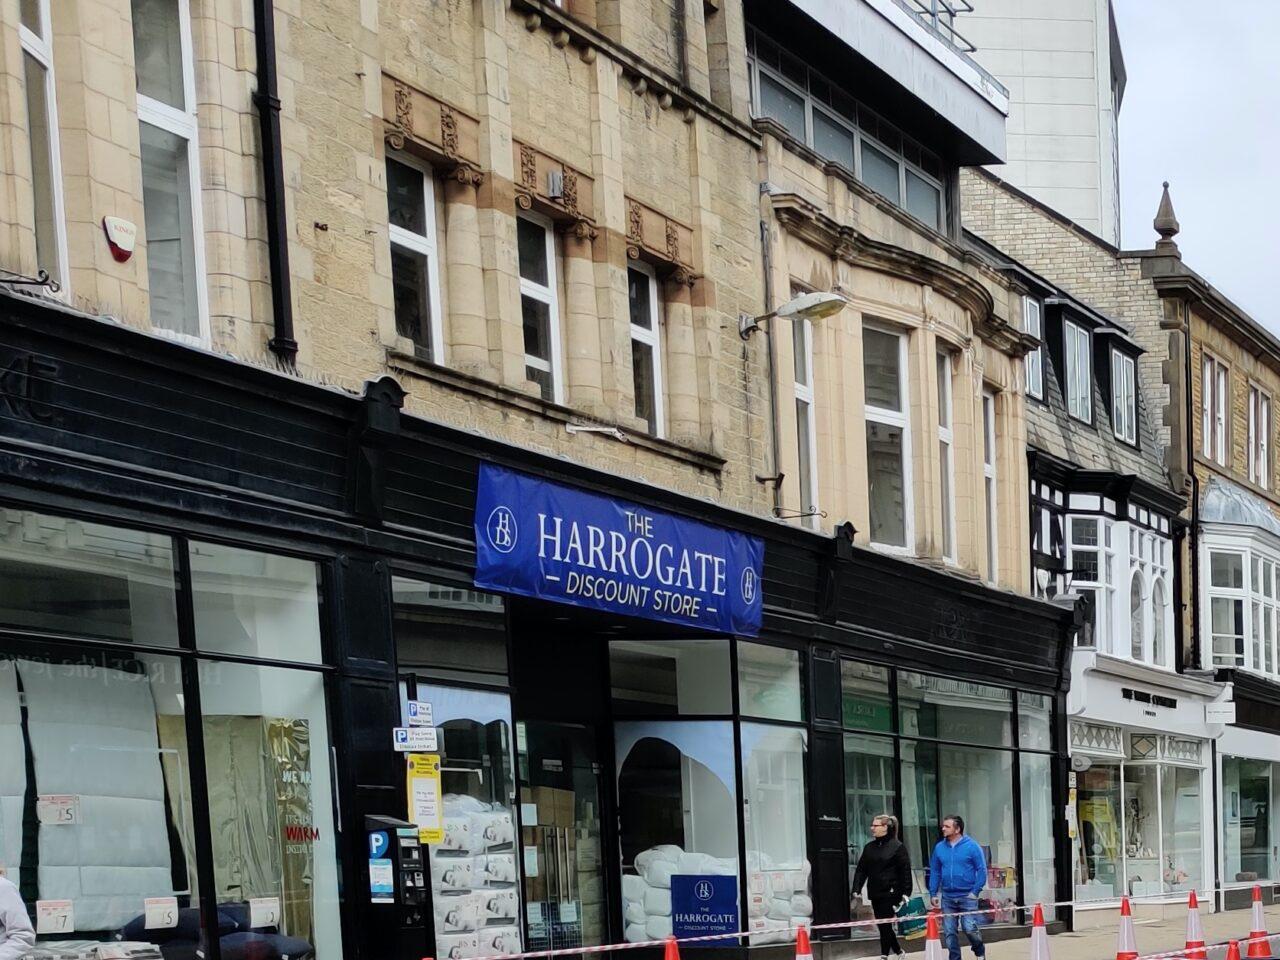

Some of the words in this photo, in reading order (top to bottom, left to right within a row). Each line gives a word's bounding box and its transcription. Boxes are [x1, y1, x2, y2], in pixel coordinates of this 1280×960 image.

[625, 511, 653, 538] THE
[538, 513, 726, 596] HARROGATE
[566, 571, 650, 607] DISCOUNT
[653, 589, 702, 617] STORE
[285, 826, 321, 842] WARM
[675, 913, 735, 923] HARROGATE
